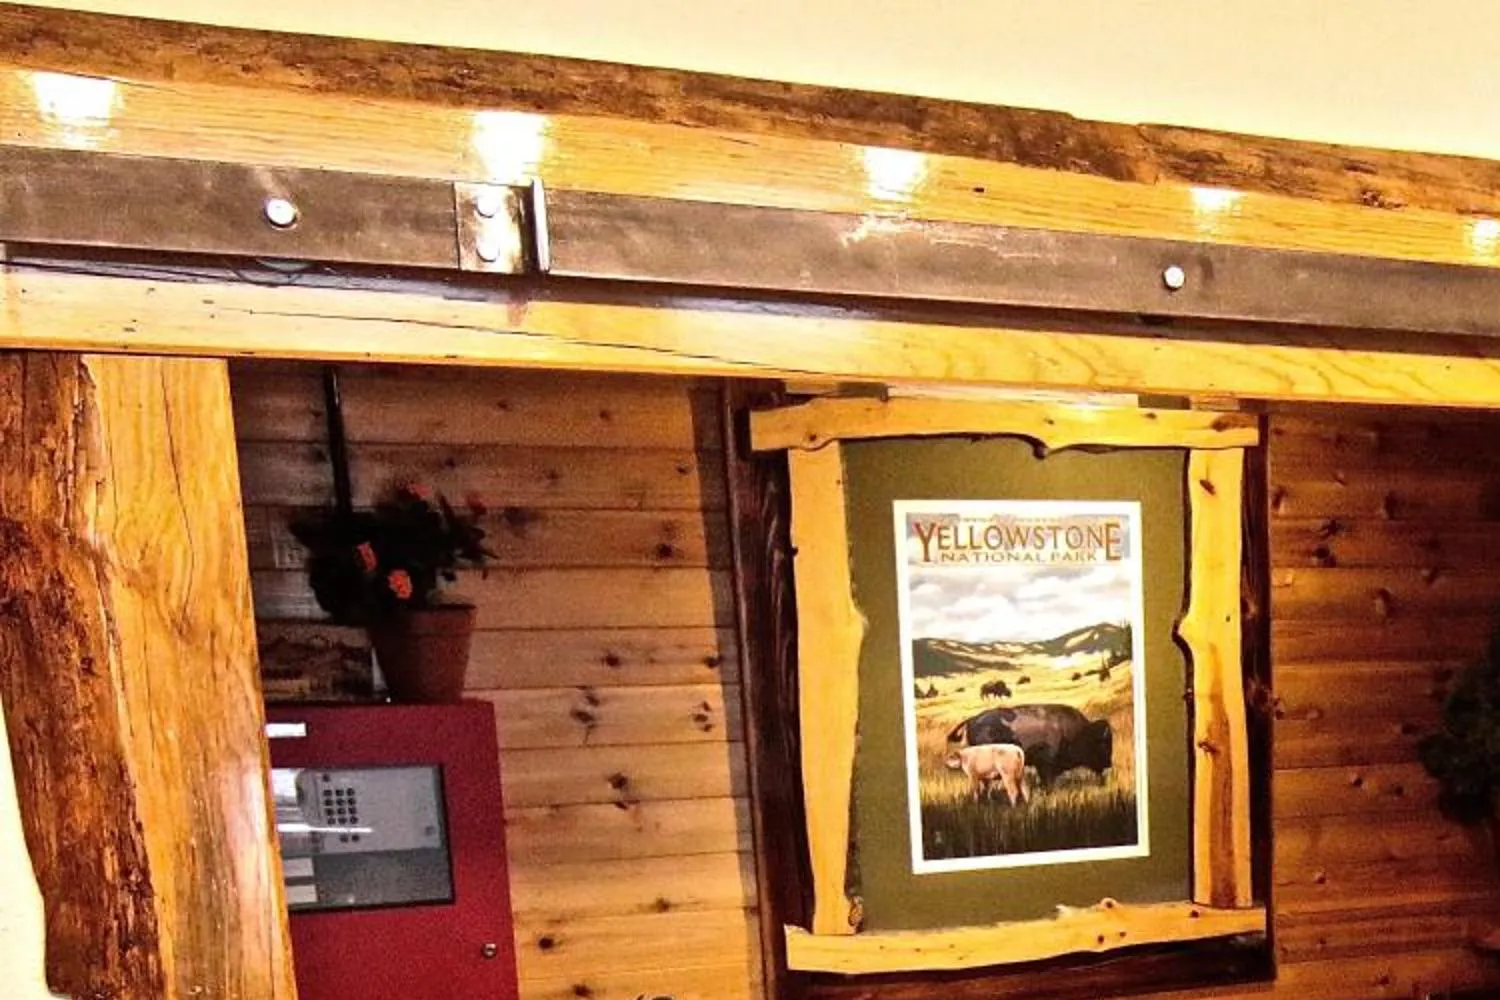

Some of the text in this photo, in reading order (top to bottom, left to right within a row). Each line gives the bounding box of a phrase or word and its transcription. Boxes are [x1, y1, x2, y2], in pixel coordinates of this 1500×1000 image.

[914, 522, 1122, 562] YELLOWSTONE
[941, 551, 1098, 563] NATIONAL PARK
